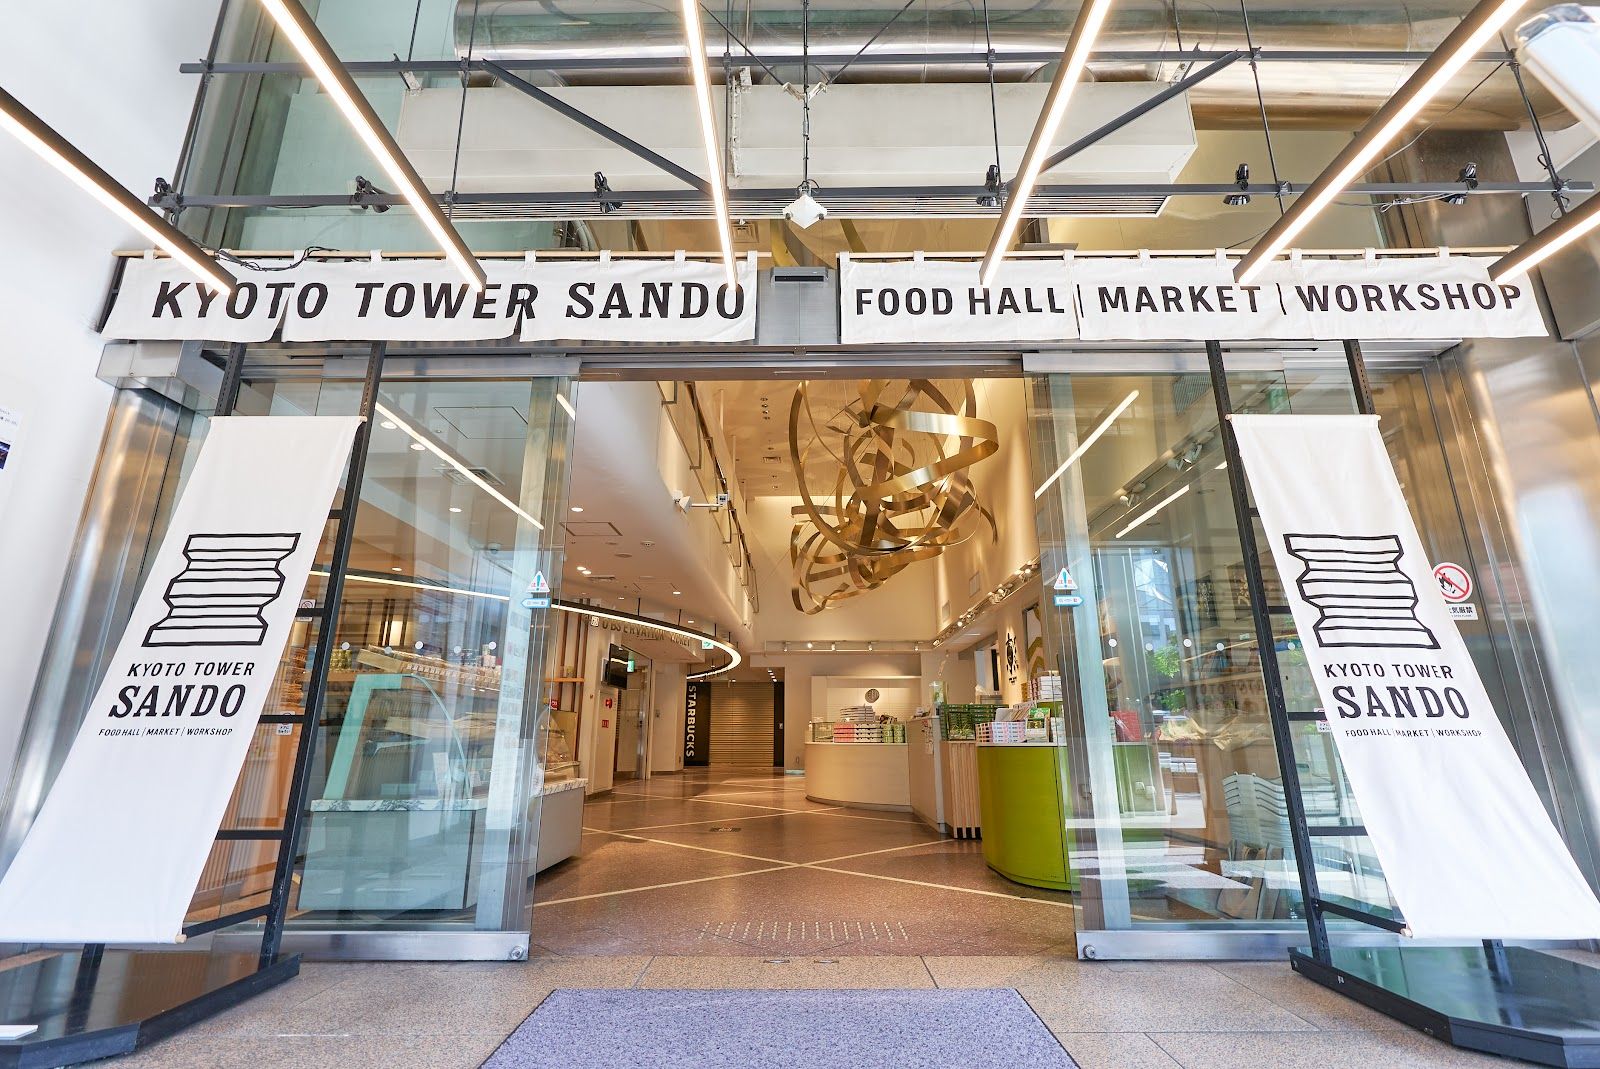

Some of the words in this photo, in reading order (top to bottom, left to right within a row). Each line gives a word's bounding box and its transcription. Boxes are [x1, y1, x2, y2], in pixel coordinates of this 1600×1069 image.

[151, 281, 329, 320] KYOTO
[354, 282, 539, 320] TOWER
[565, 282, 745, 320] SANDO
[856, 287, 953, 316] FOOD
[968, 287, 1065, 316] HALL
[1097, 285, 1261, 313] MARKET
[1294, 282, 1521, 312] WORKSHOP
[127, 662, 186, 677] KYOTO
[193, 662, 255, 676] TOWER
[1323, 663, 1386, 678] KYOTO
[1391, 663, 1454, 679] TOWER
[107, 683, 246, 719] SANDO
[1332, 685, 1470, 719] SANDO
[98, 728, 121, 736] FOOD
[121, 728, 140, 736] HALL
[146, 728, 180, 736] MARKET
[186, 728, 233, 736] WORKSHOP
[685, 685, 697, 757] STARBUCKS
[1345, 728, 1369, 737] FOOD
[1370, 728, 1392, 736] HALL
[1395, 728, 1429, 737] MARKET
[1436, 729, 1482, 737] WORKSHOP
